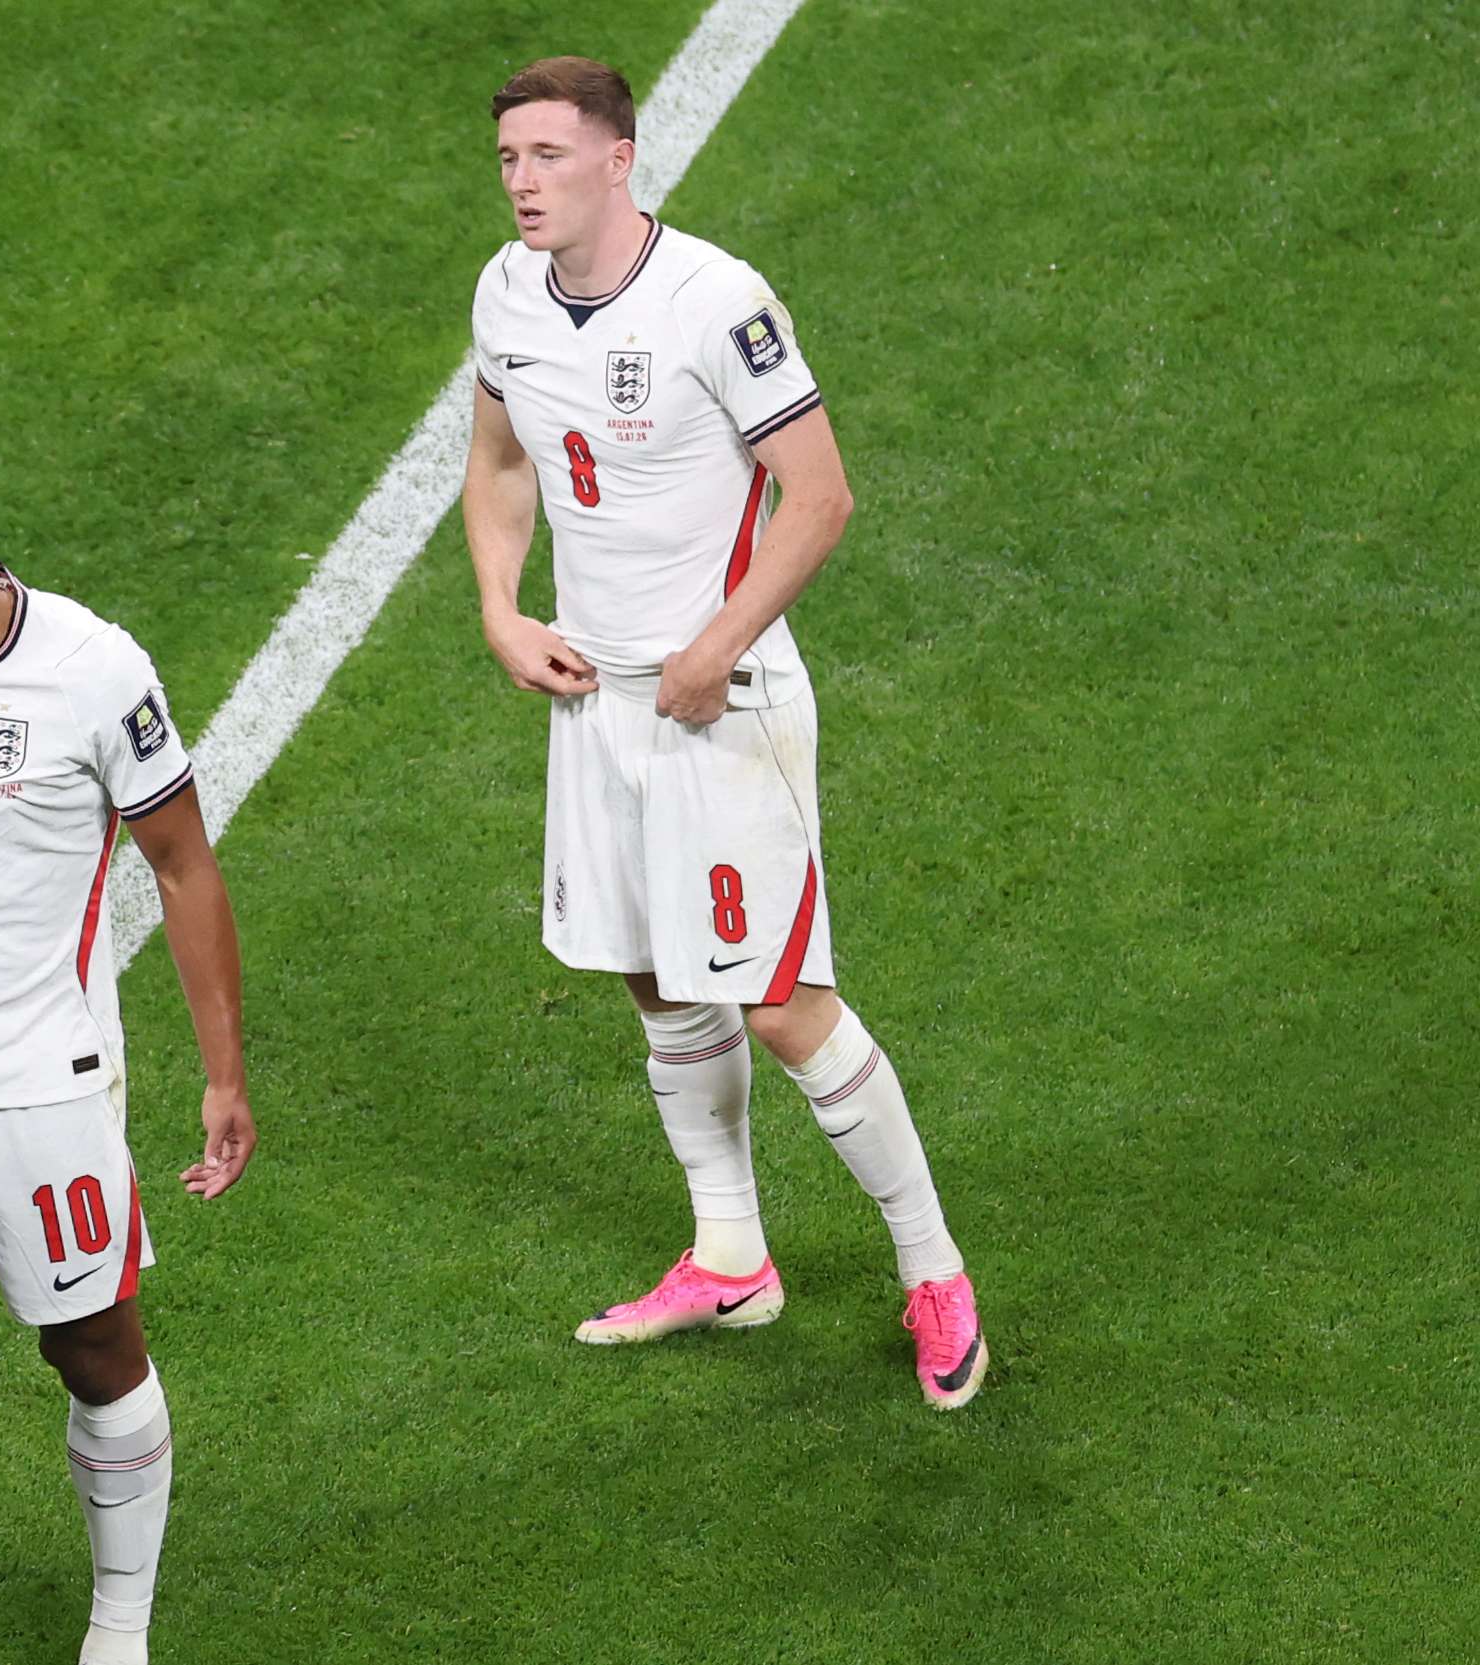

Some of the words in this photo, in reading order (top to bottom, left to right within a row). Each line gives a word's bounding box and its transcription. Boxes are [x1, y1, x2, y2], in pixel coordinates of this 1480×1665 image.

[607, 419, 654, 430] ARGENTINA
[616, 431, 647, 441] 15.07.26
[563, 431, 600, 507] 8
[709, 864, 747, 943] 8
[32, 1175, 111, 1262] 10
